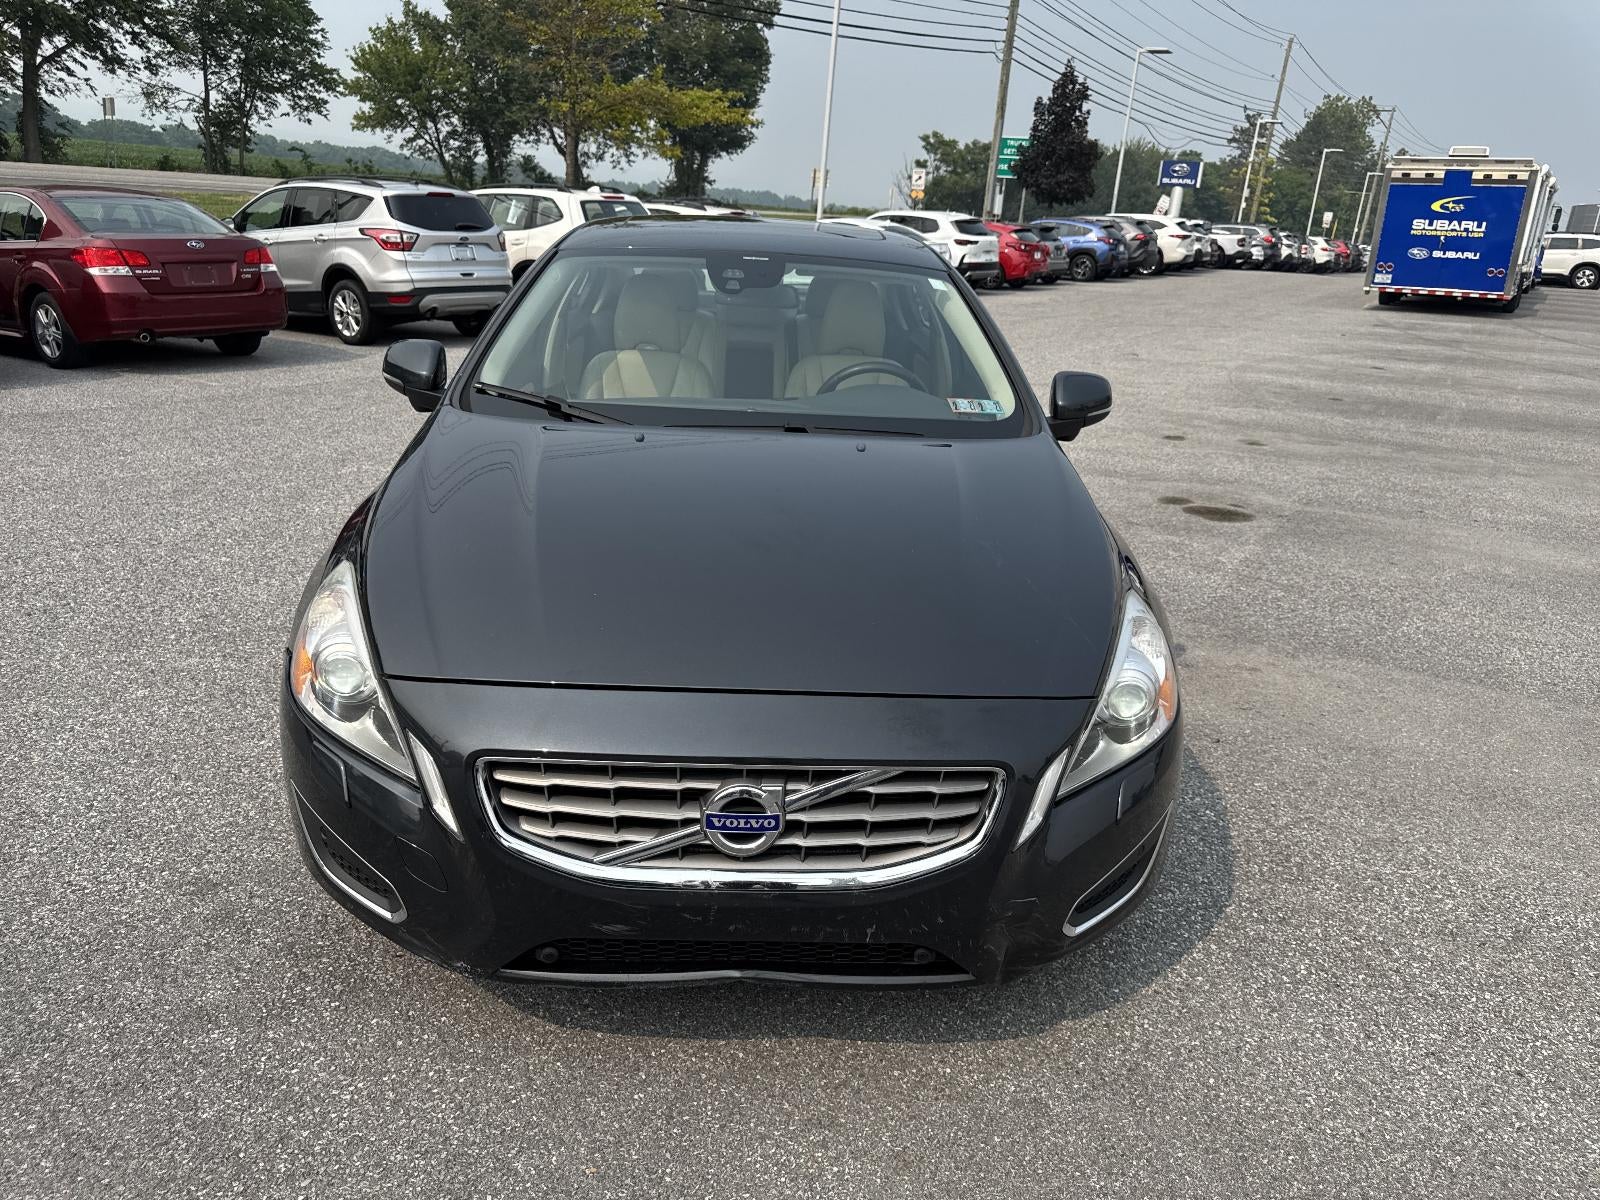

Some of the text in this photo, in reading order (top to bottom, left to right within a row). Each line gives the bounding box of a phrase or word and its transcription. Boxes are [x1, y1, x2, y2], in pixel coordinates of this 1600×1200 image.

[1161, 177, 1195, 185] SUBARU
[1411, 218, 1486, 232] SUBARU
[1410, 229, 1467, 237] MOTORSPORTS
[1432, 250, 1480, 260] SUBARU
[709, 817, 776, 828] VOLVO
